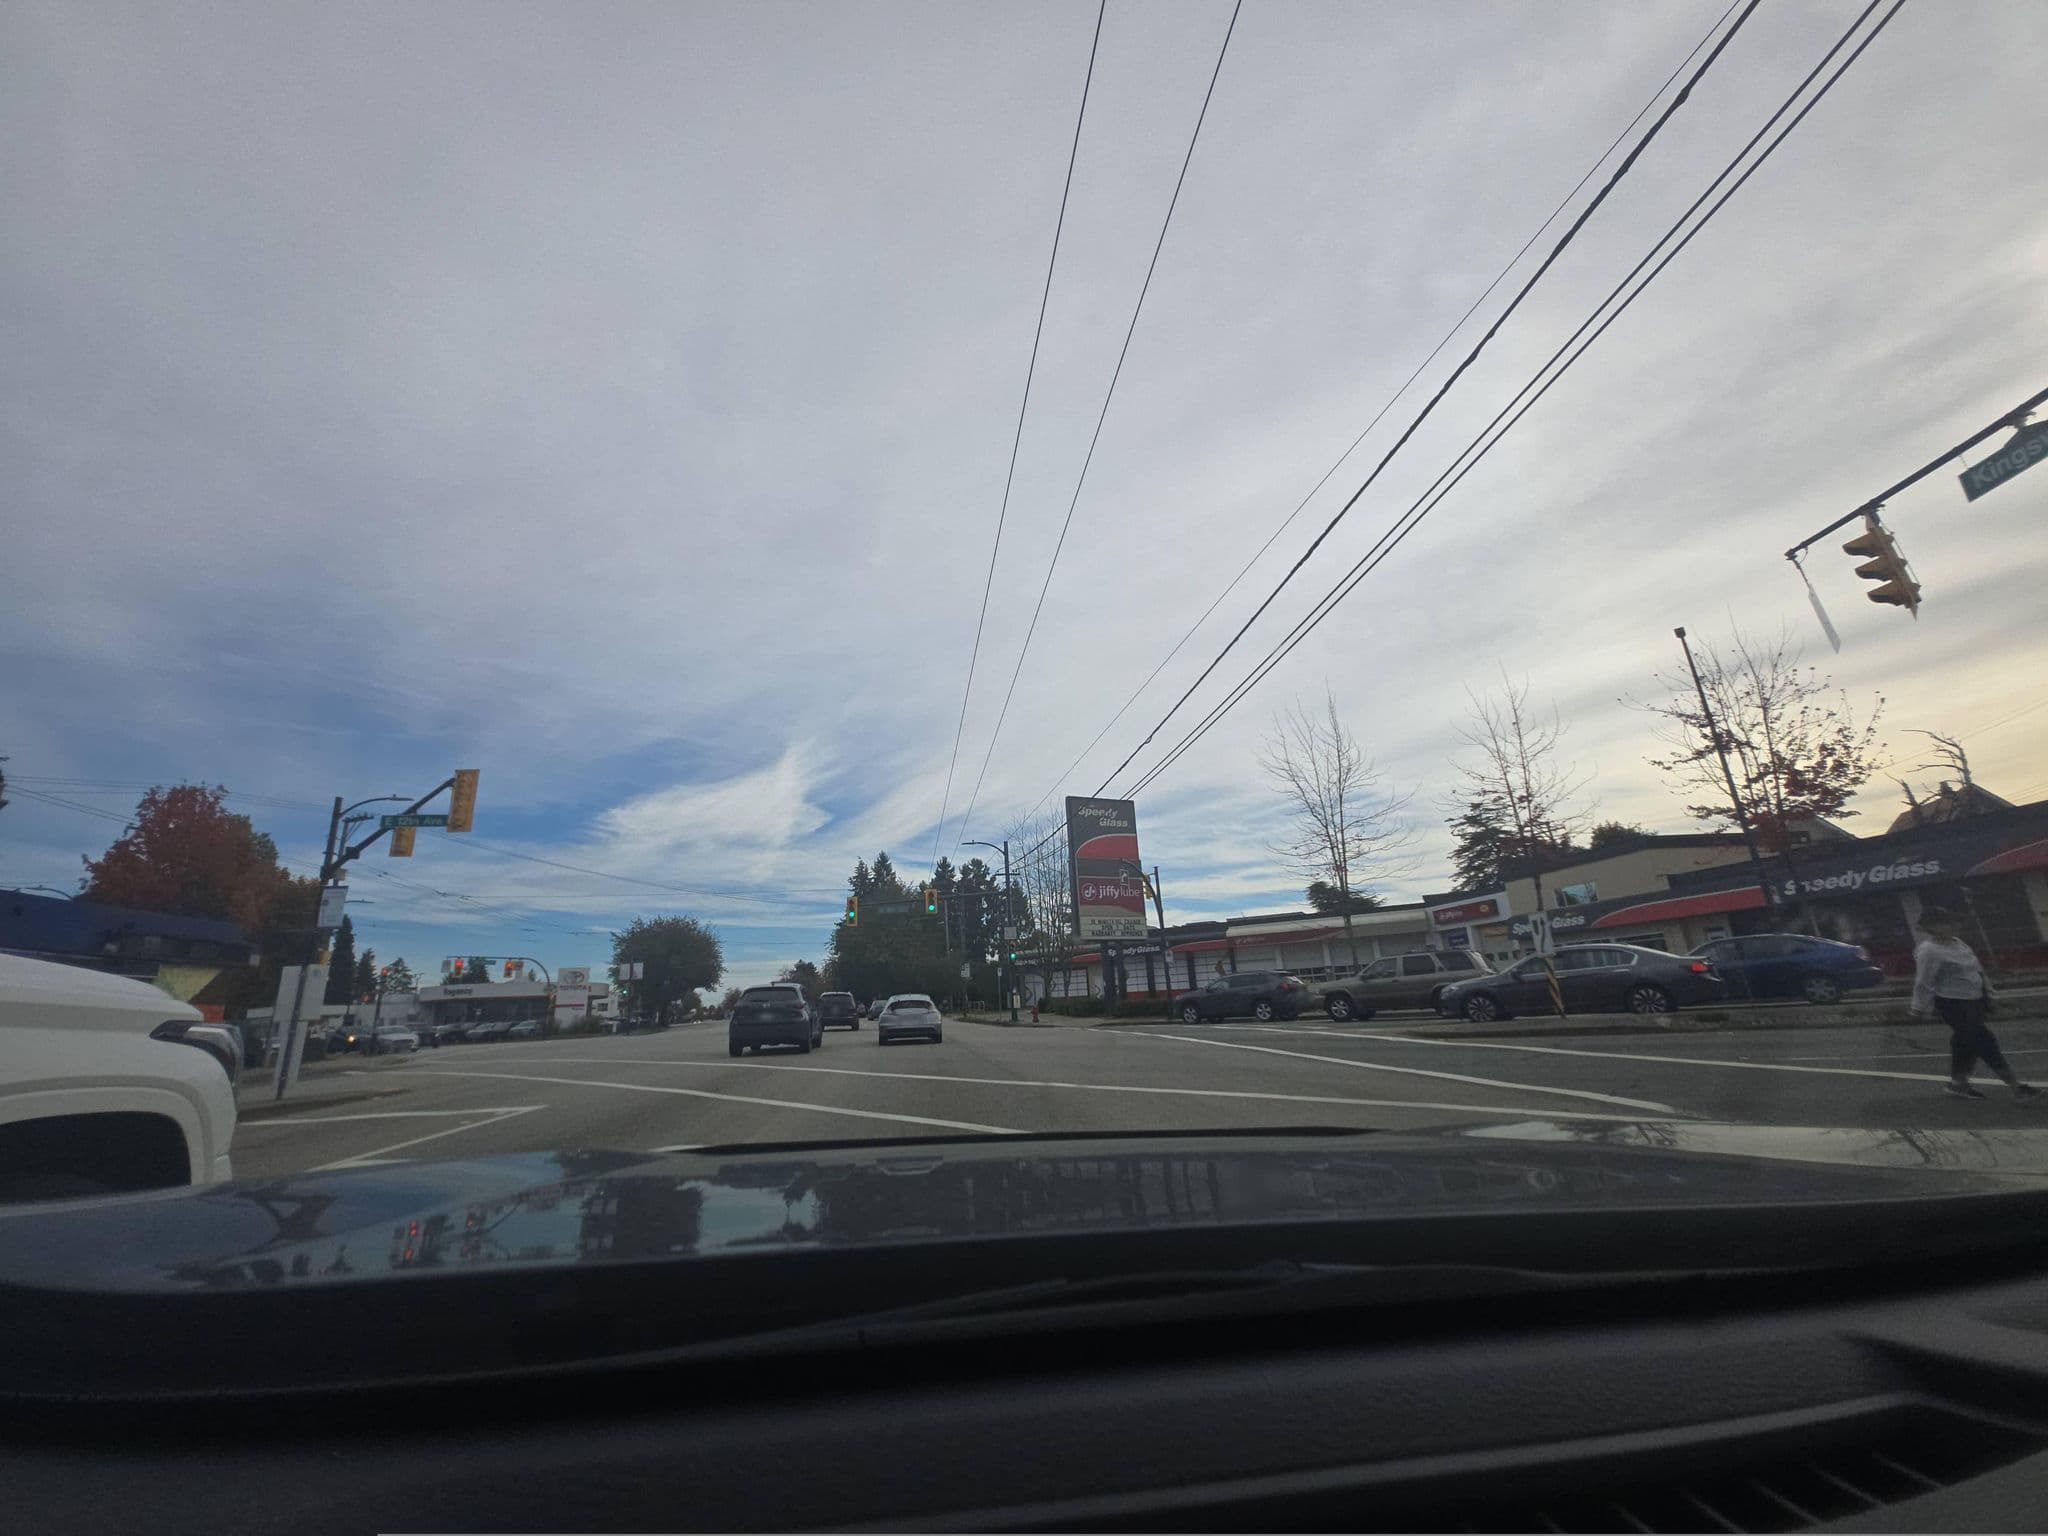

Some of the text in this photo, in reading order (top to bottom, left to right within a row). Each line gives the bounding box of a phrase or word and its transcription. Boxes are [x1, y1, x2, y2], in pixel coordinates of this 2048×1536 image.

[1971, 434, 2048, 489] Kings
[1099, 817, 1128, 827] Glass
[1869, 860, 1942, 883] Glass
[1552, 915, 1585, 928] Glass
[1108, 945, 1161, 957] Spedy Glass
